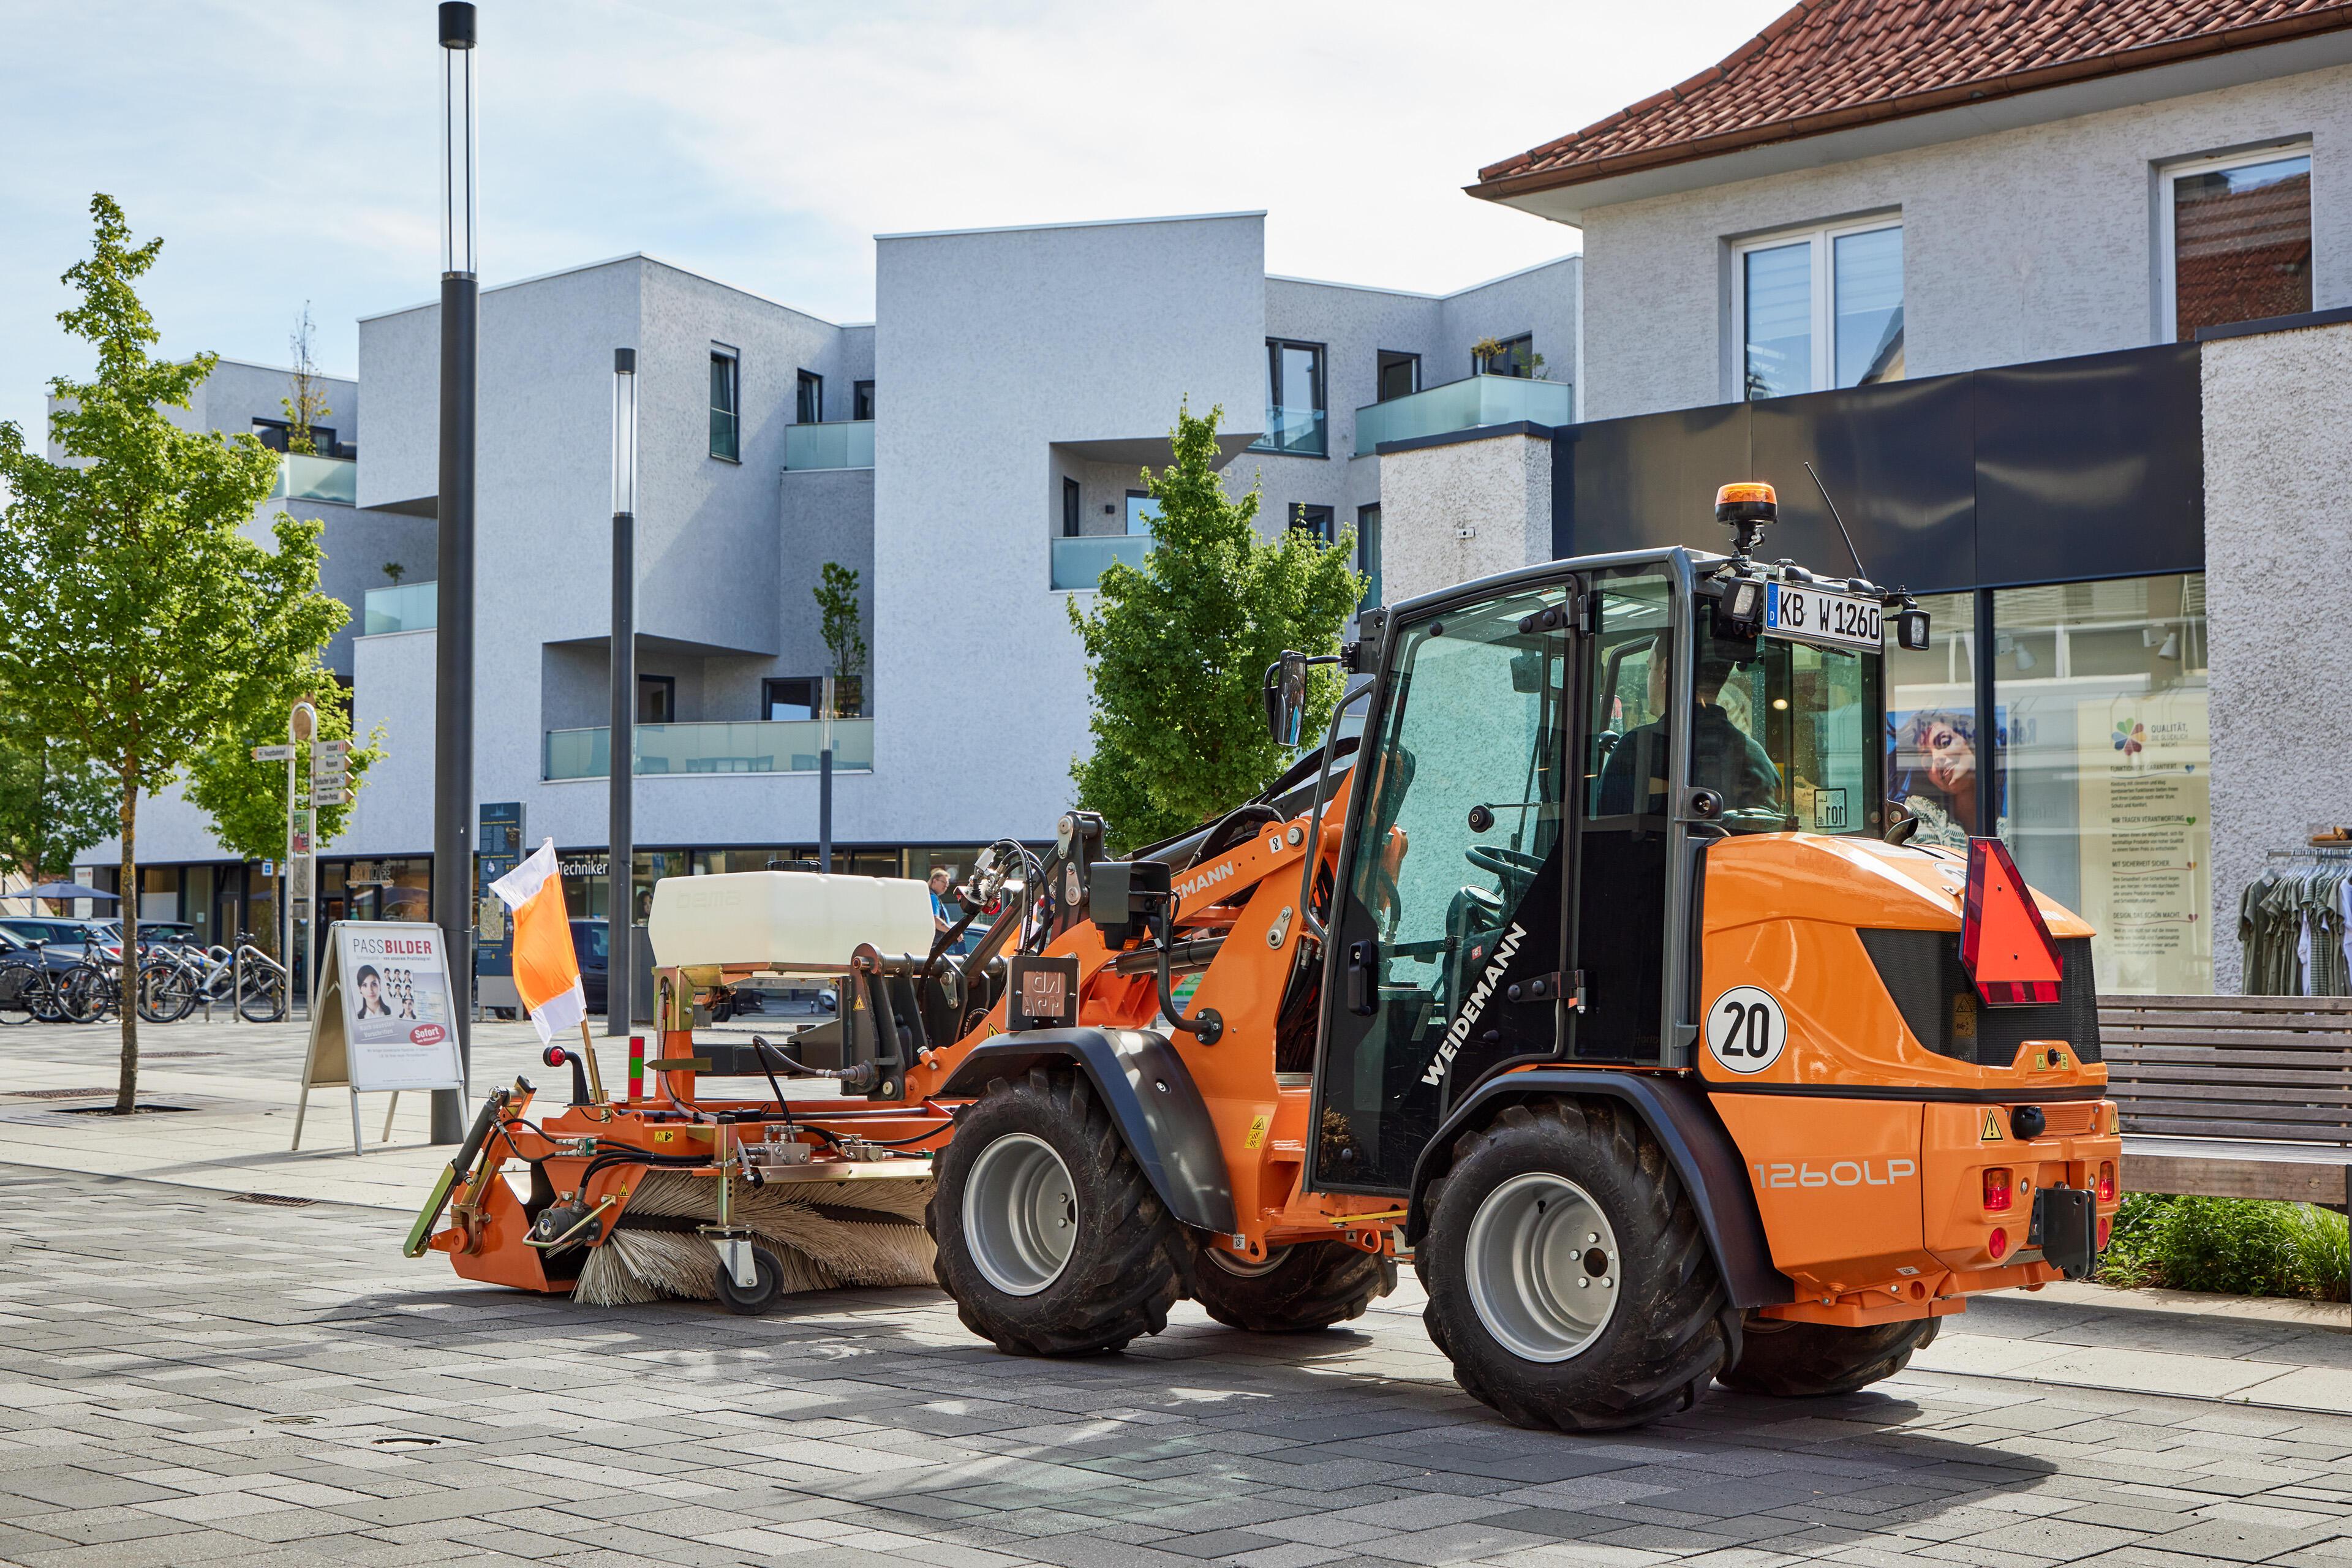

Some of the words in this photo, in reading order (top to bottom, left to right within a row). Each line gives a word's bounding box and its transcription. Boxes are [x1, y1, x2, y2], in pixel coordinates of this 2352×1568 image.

[1770, 611, 1774, 621] D
[1780, 591, 1804, 627] KB
[2151, 722, 2188, 733] QUALITÄT,
[559, 861, 608, 876] Techniker
[353, 938, 432, 954] PASSBILDER
[1421, 921, 1527, 1086] WEIDEMANN
[415, 1027, 439, 1039] Sofort
[1722, 1001, 1770, 1058] 20
[1754, 1158, 1916, 1189] 1260LP
